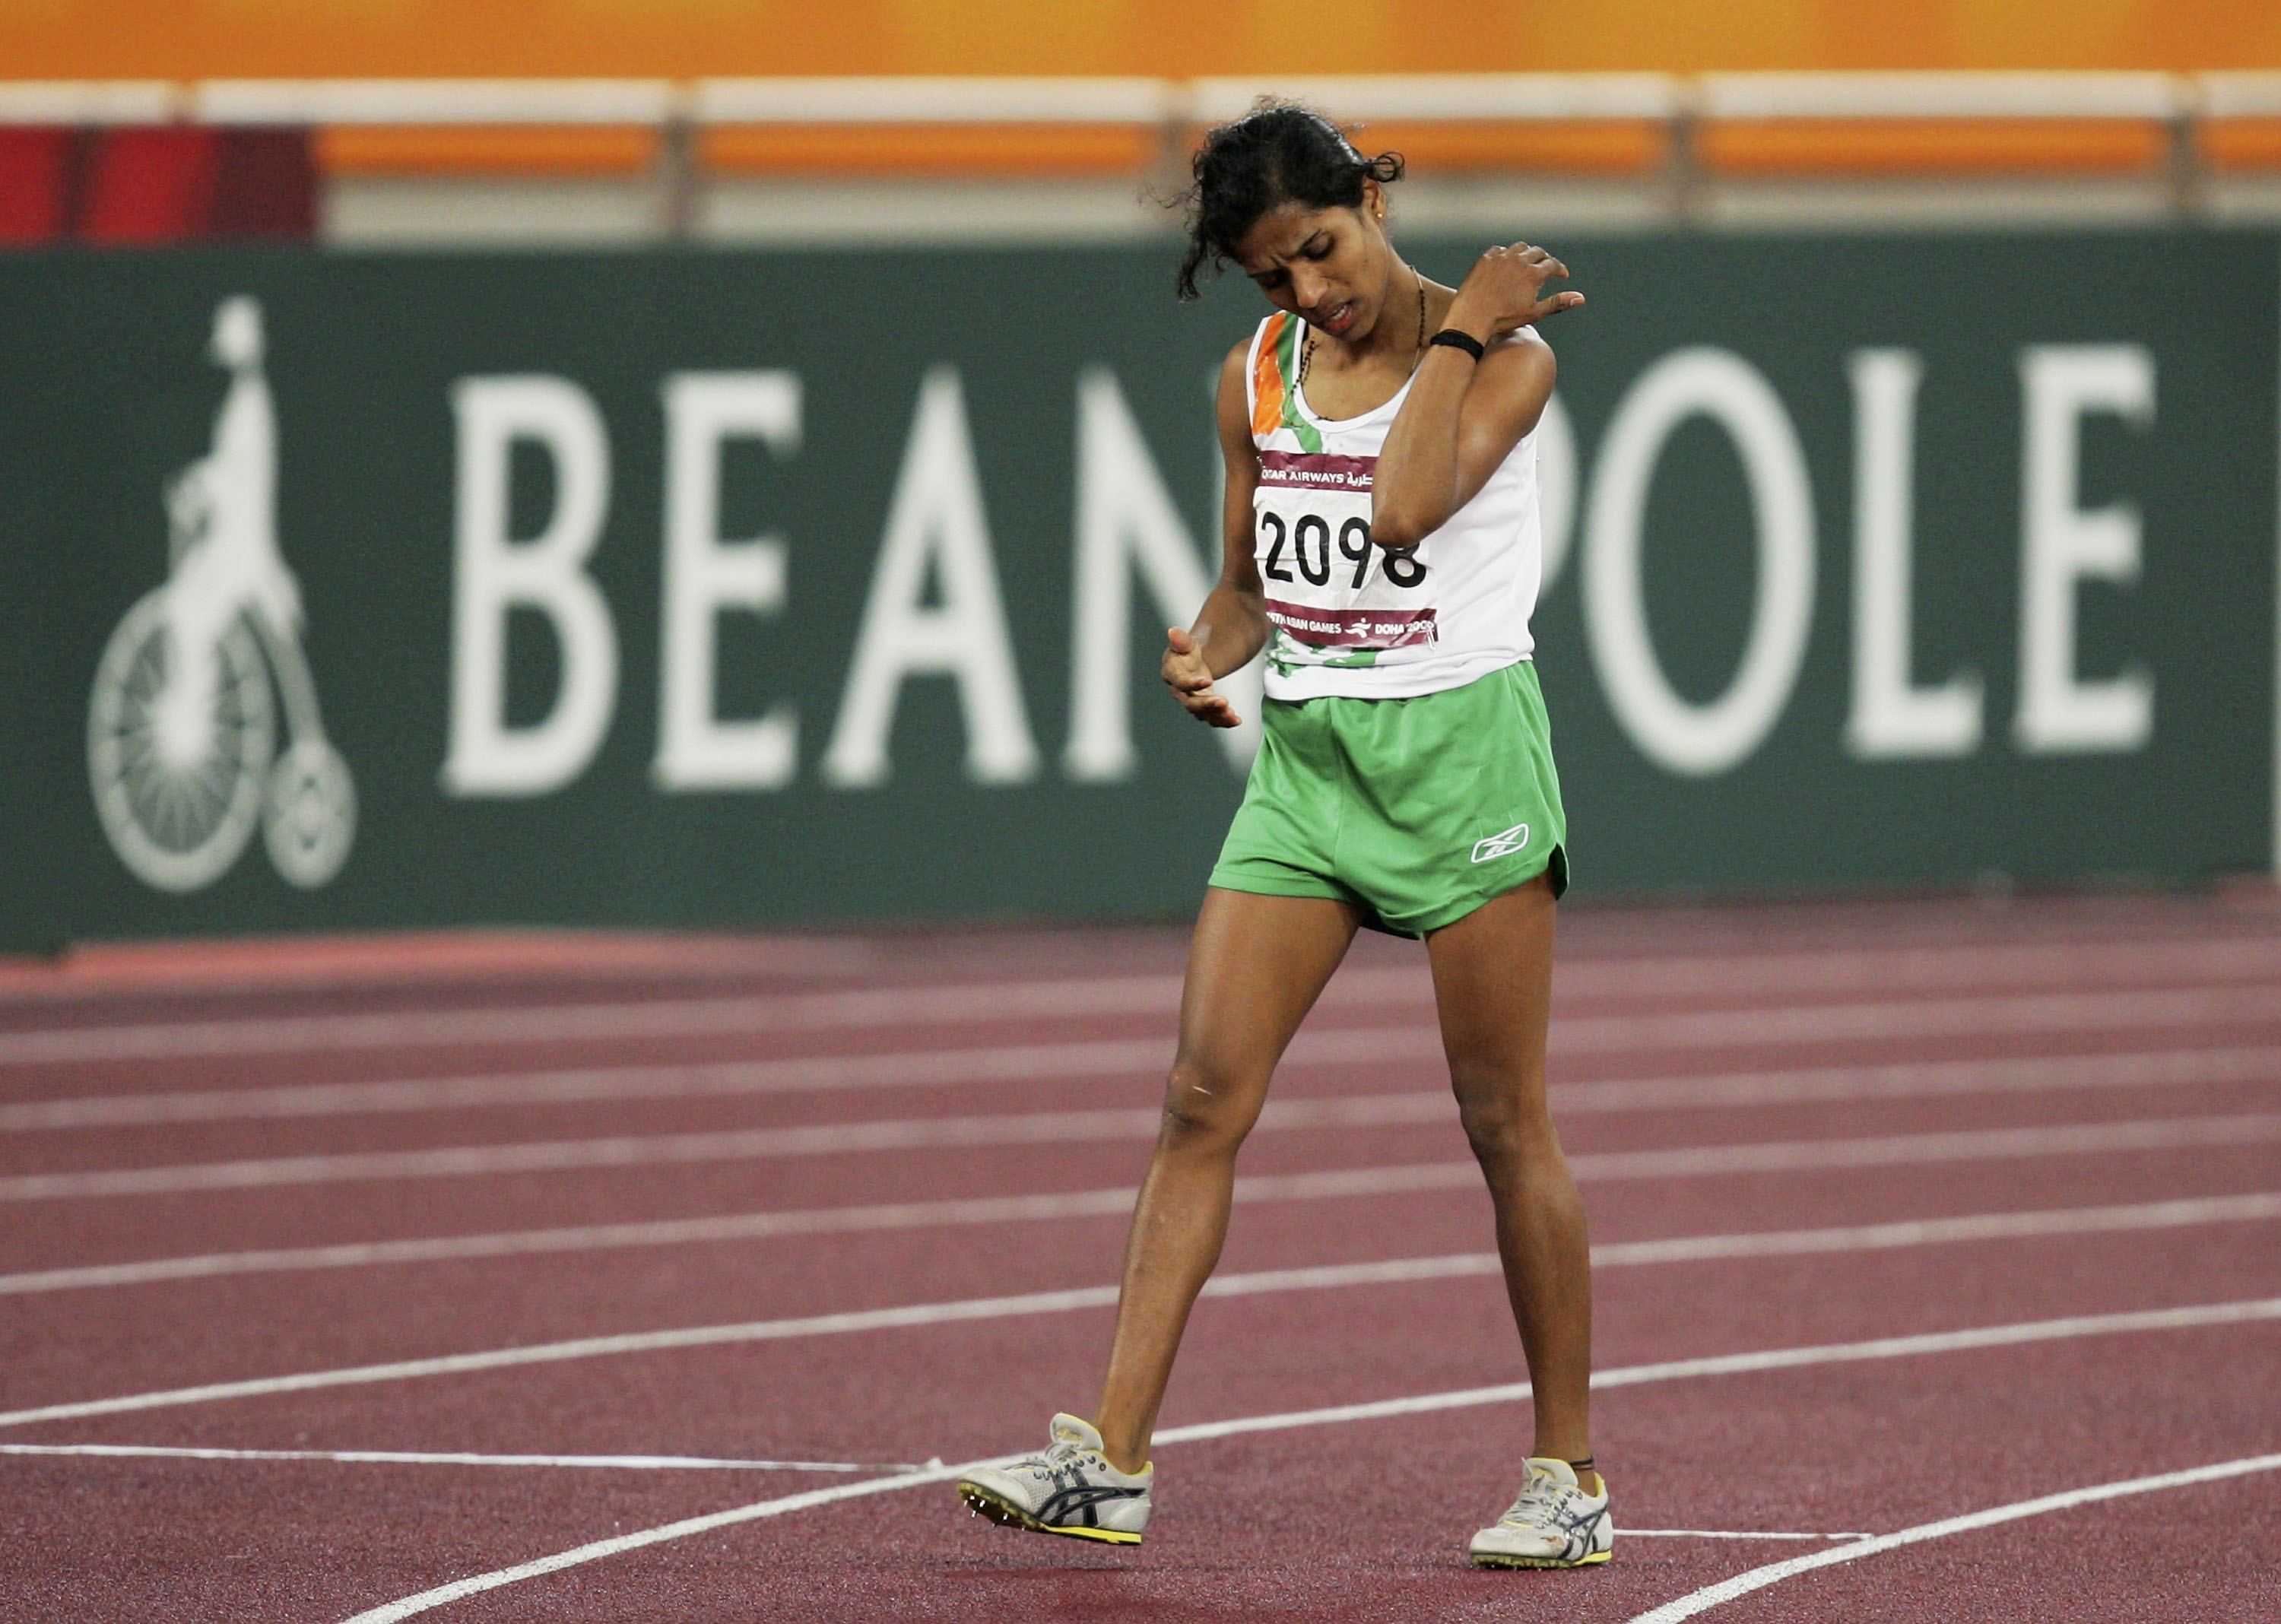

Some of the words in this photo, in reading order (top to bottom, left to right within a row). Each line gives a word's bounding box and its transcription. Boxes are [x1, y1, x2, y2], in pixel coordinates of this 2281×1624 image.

[1290, 471, 1344, 484] AIRWAYS
[1261, 511, 1426, 588] 2098
[441, 362, 1264, 797] BEAN
[1539, 342, 2156, 776] OLE
[1309, 620, 1342, 634] GAMES
[1375, 623, 1404, 635] DOHA
